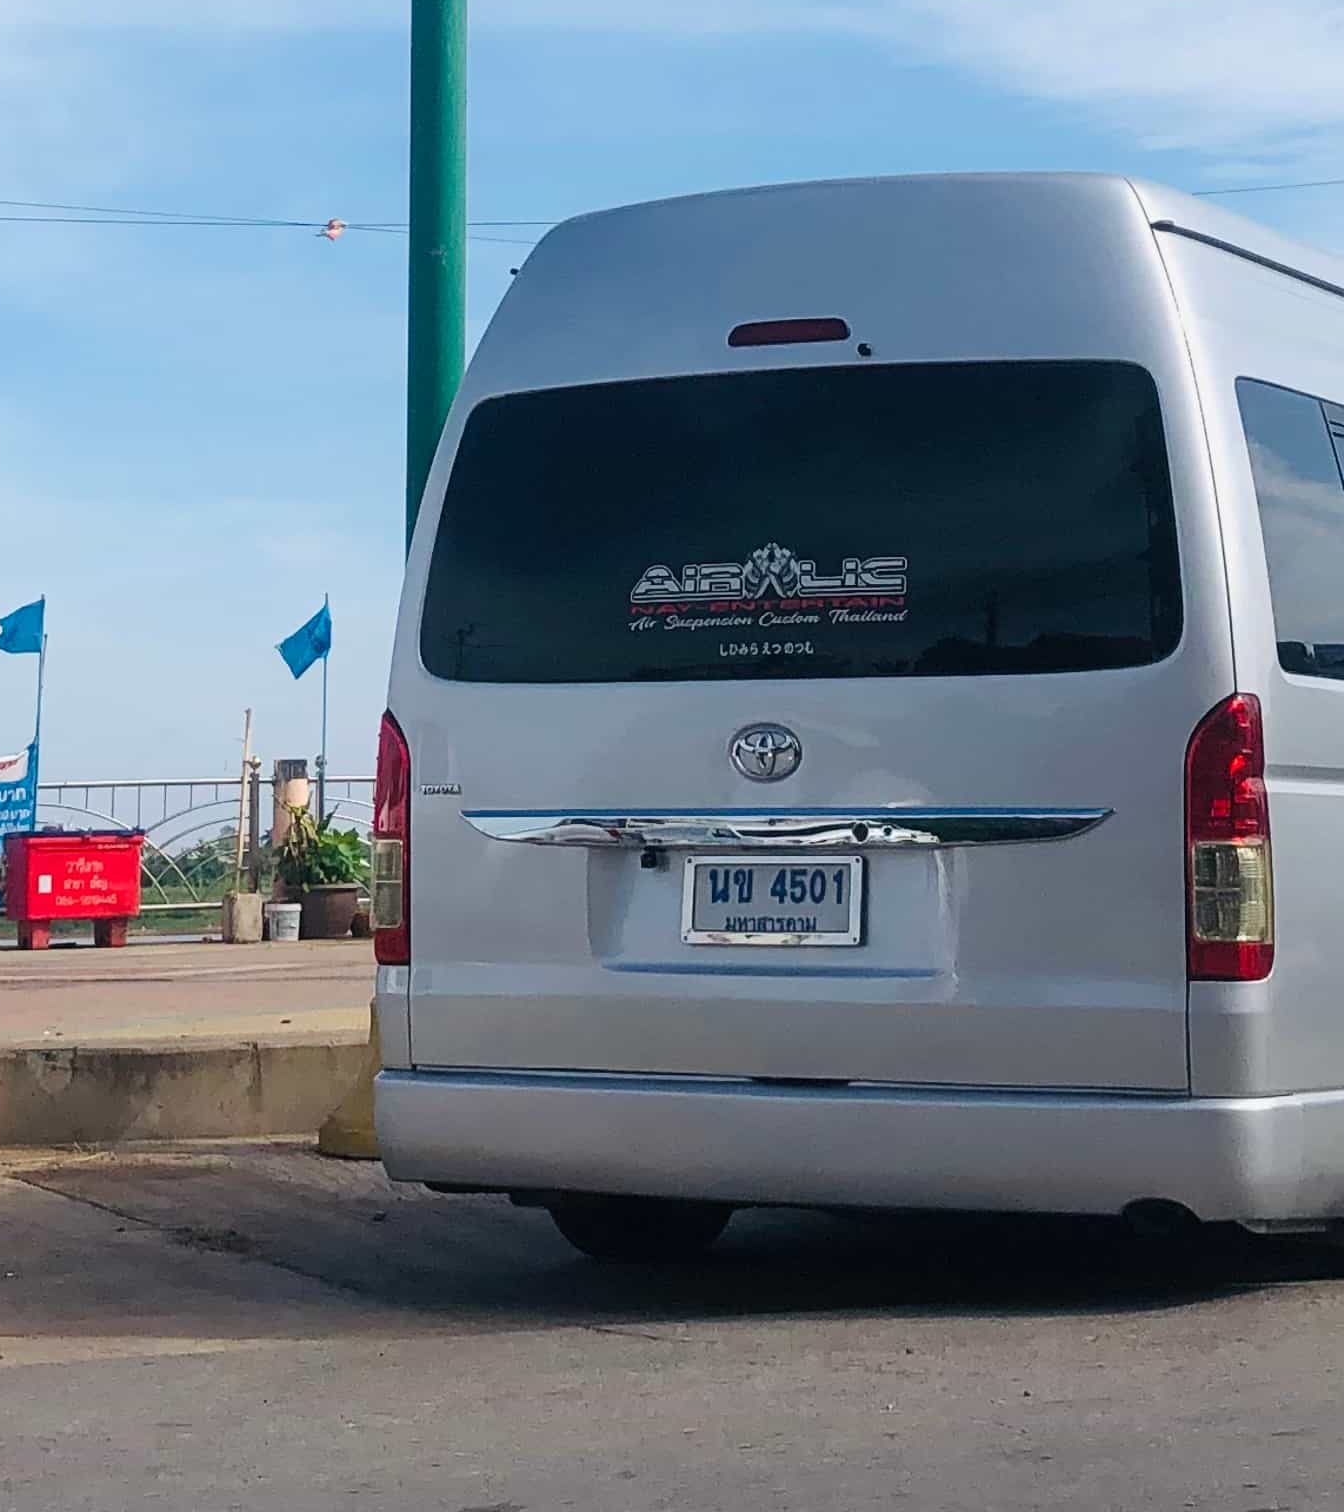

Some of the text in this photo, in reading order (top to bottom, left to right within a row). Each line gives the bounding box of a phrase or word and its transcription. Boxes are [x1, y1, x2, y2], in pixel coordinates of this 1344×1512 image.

[628, 608, 908, 631] Air Suspension Custom Thailand
[420, 784, 462, 795] TOYOTA
[770, 869, 844, 905] 4501
[725, 916, 817, 932] มหาสารคาม
